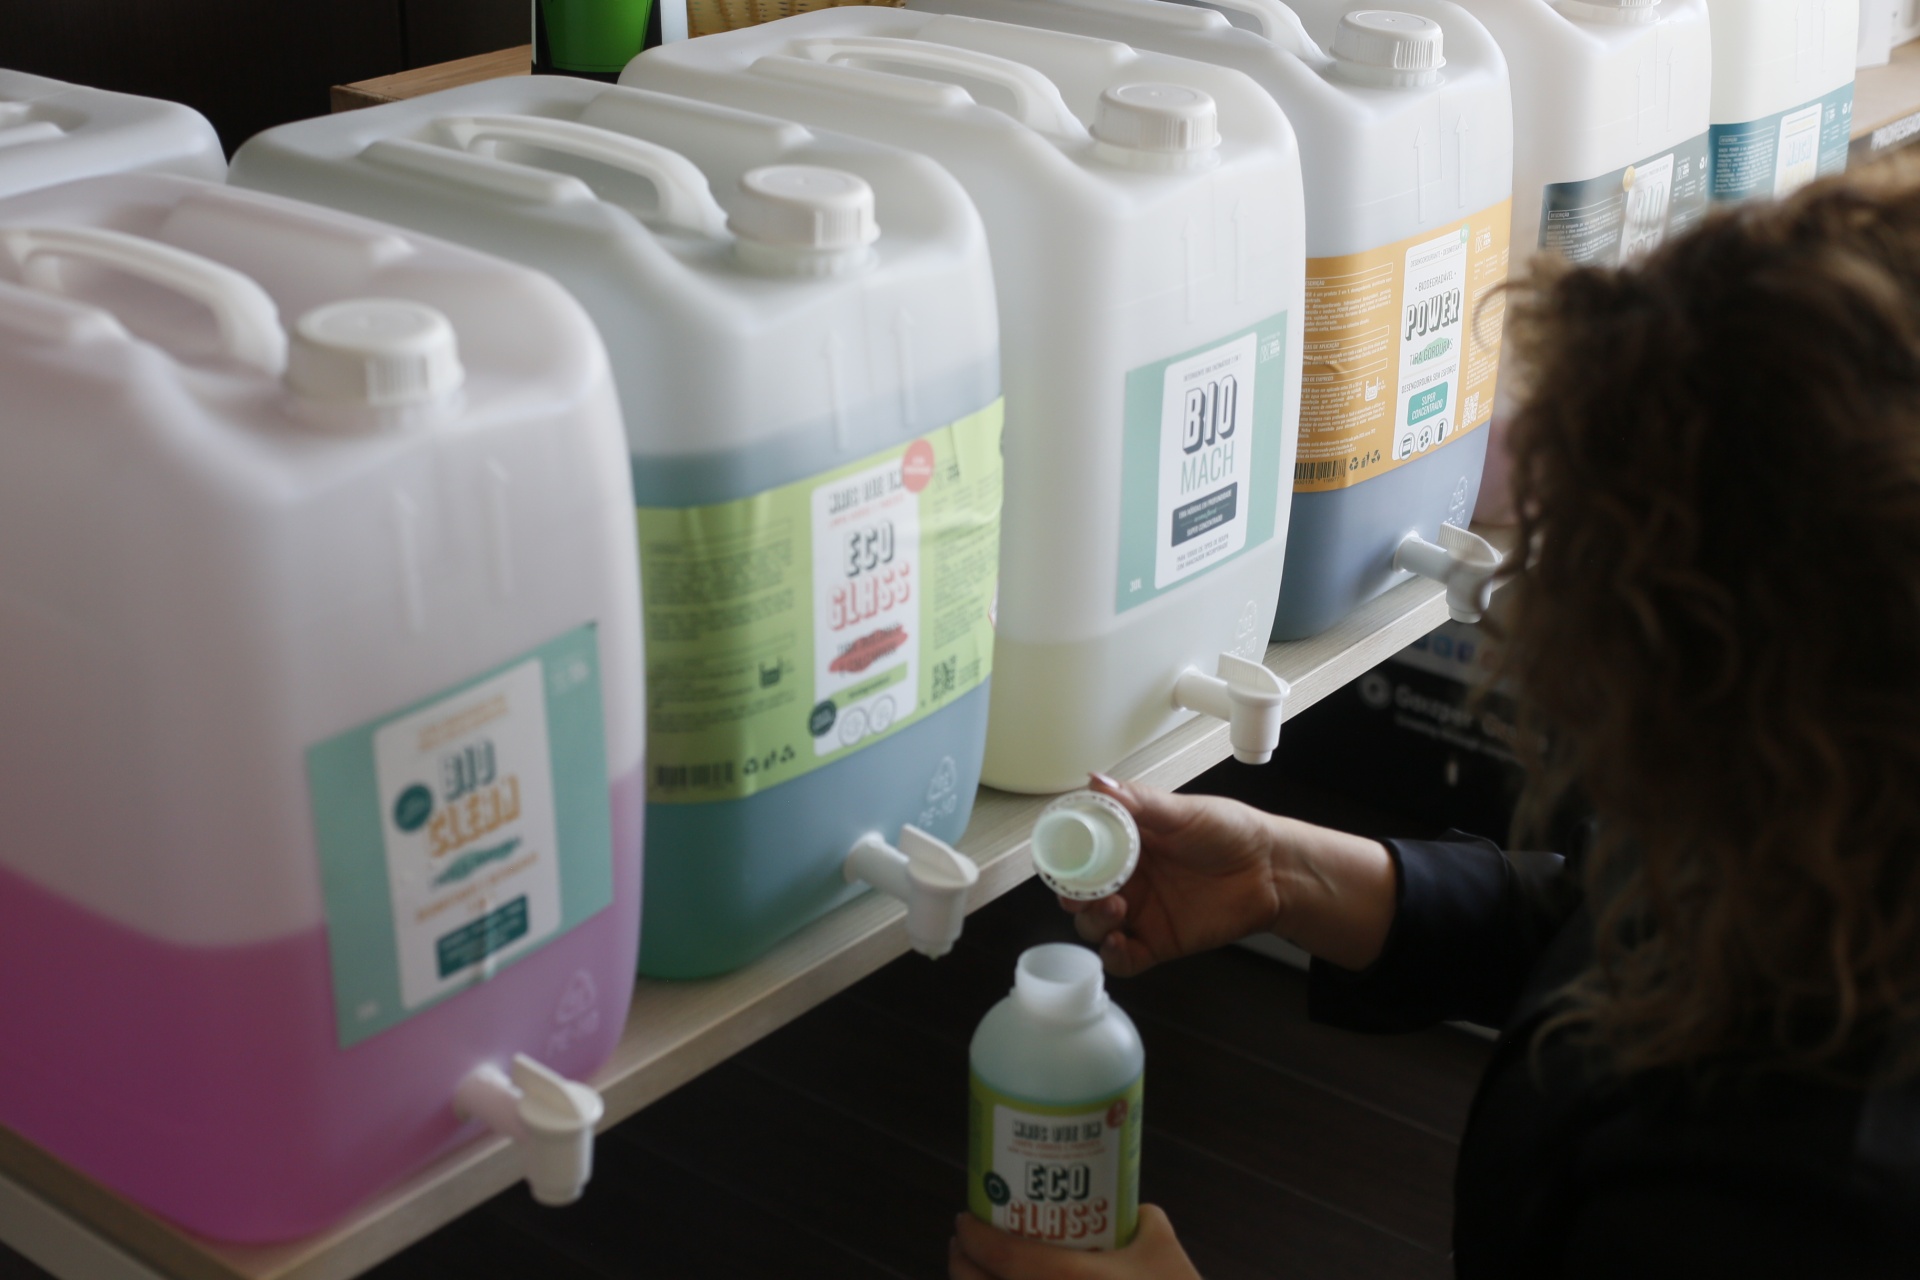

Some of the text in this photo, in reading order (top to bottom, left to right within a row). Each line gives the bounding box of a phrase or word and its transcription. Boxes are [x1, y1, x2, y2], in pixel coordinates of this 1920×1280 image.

[1305, 279, 1325, 287] ESCRIÇÃO
[1418, 270, 1453, 291] BIODEGRADÁVEL
[1405, 287, 1460, 341] POWER
[1409, 351, 1422, 366] TIRA
[1422, 338, 1454, 362] GORDURAS
[1401, 375, 1432, 394] DESENGORDURA
[1441, 363, 1457, 378] ESFORÇO
[1421, 391, 1436, 406] SUPER
[1182, 374, 1238, 455] BIO
[1411, 398, 1444, 420] CONCENTRADO
[1180, 440, 1235, 495] MACH
[843, 519, 895, 578] ECO
[827, 561, 911, 631] GLASS
[1025, 1161, 1090, 1203] ECO
[1005, 1196, 1108, 1240] GLASS
